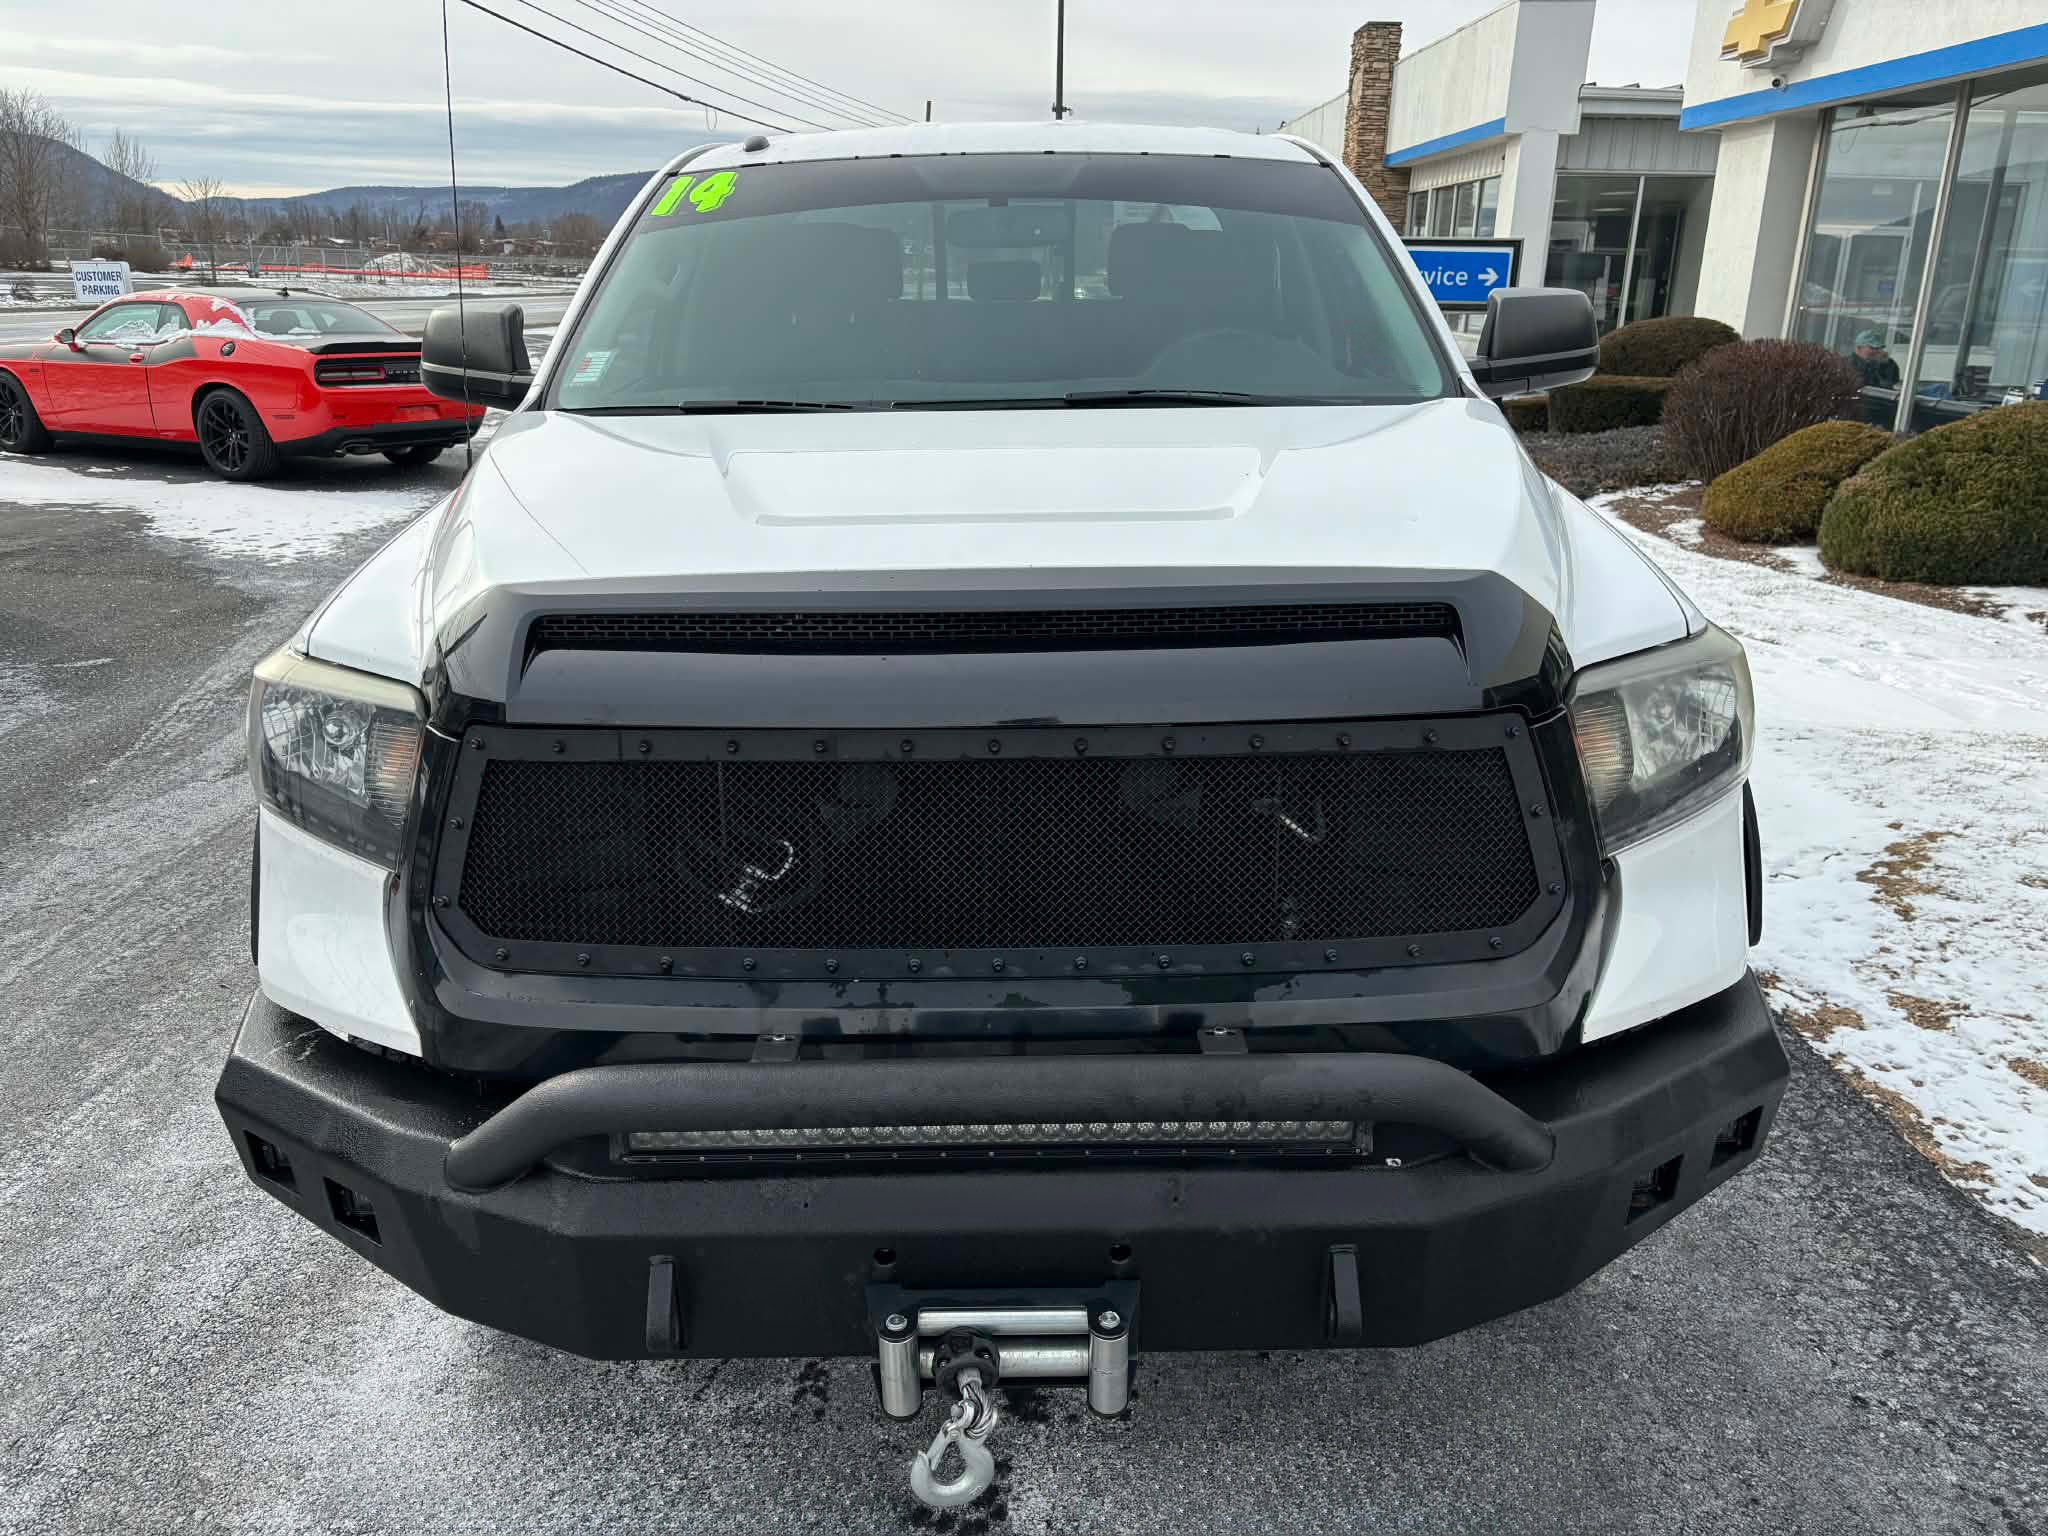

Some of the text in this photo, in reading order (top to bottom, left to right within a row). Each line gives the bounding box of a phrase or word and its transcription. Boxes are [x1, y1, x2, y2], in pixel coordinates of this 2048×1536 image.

[649, 172, 736, 216] 14
[75, 271, 122, 282] CUSTOMER
[82, 284, 120, 295] PARKING
